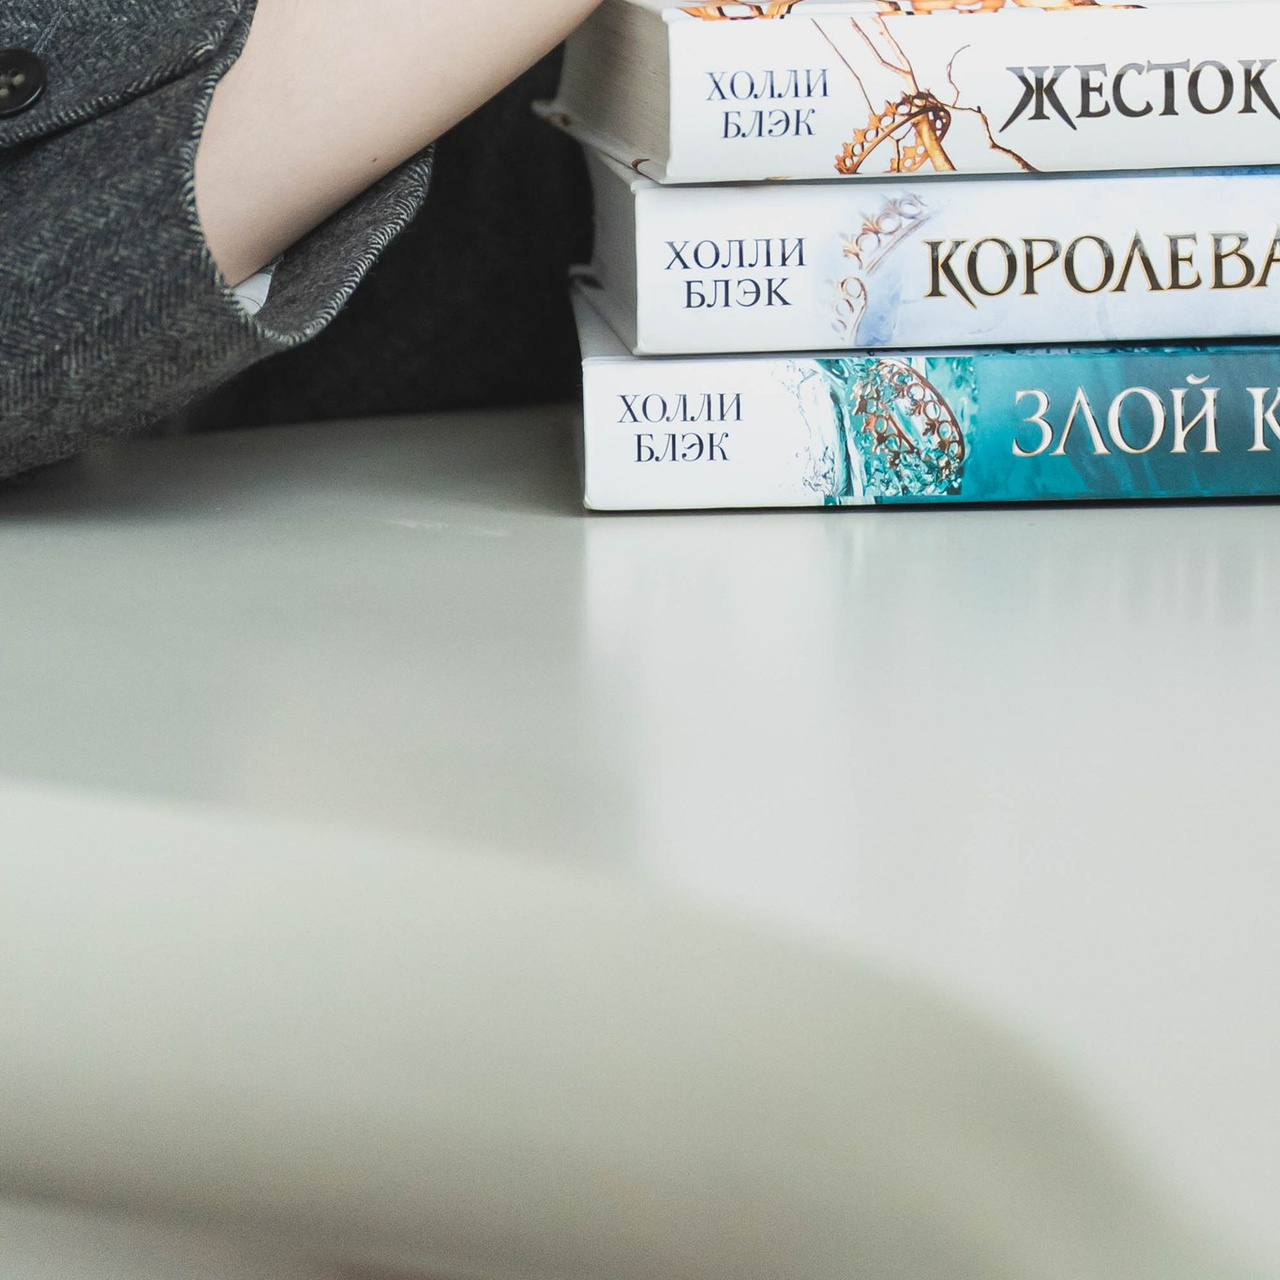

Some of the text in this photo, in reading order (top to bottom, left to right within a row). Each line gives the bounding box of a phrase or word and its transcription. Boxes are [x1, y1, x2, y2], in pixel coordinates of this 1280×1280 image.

[705, 68, 830, 101] ХОЛЛИ
[721, 108, 816, 139] БЛЭК
[663, 237, 807, 271] ХОЛЛИ
[683, 277, 794, 309] БЛЭК
[616, 392, 744, 424] ХОЛЛИ
[1010, 372, 1220, 457] ЗЛОЙ
[634, 431, 731, 462] БЛЭК
